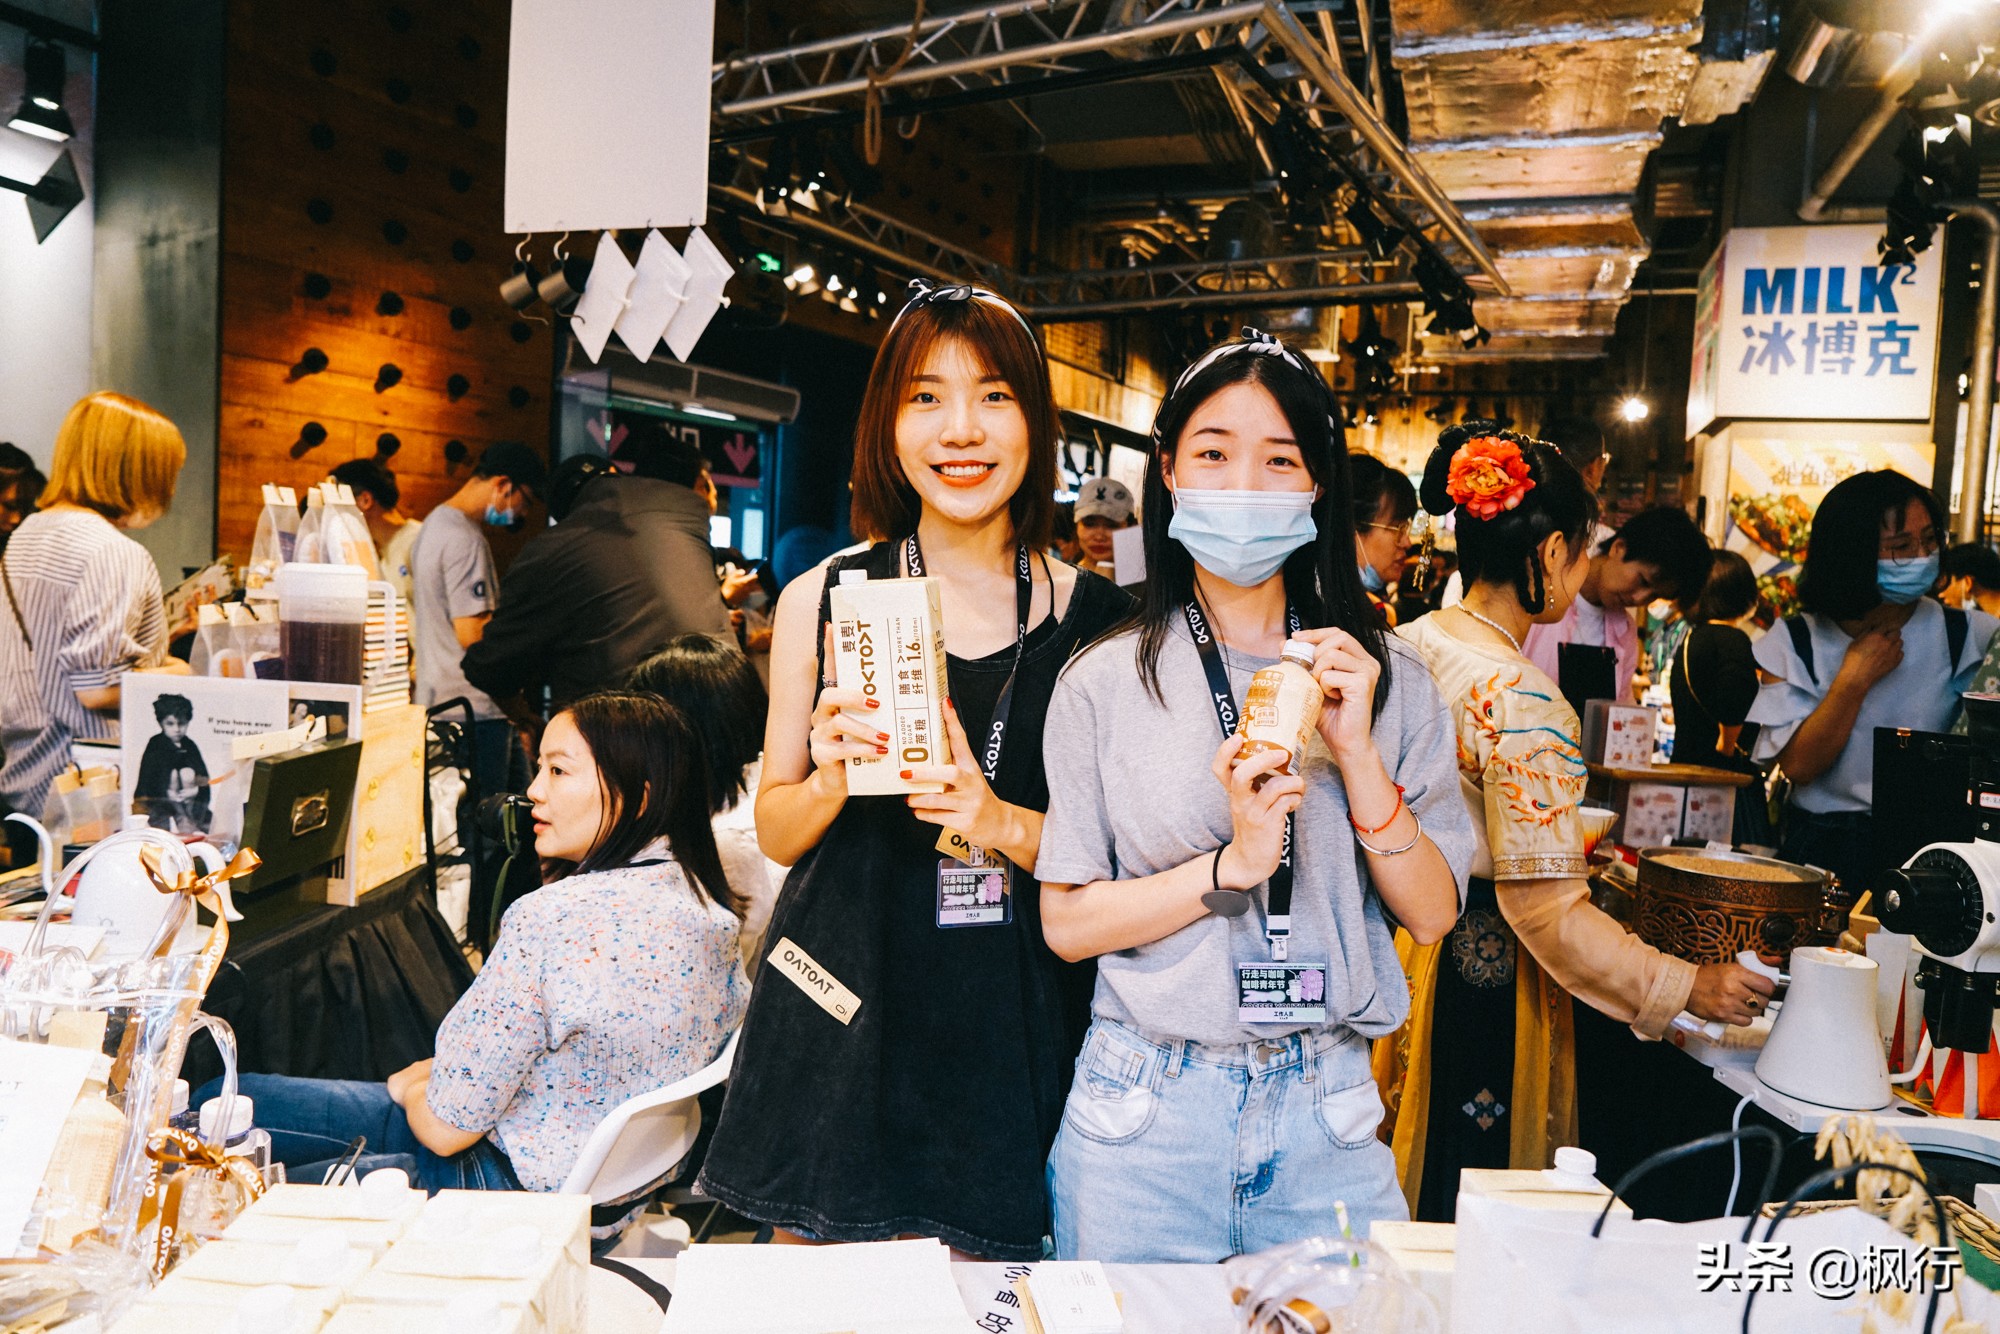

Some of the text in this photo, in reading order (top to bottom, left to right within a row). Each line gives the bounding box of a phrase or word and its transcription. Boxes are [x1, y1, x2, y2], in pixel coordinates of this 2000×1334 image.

[1739, 319, 1919, 377] 冰博克
[899, 670, 911, 695] 膳食
[911, 668, 924, 695] 纤维
[233, 719, 252, 727] have
[213, 728, 236, 736] loved
[914, 719, 928, 745] 蔗糖
[901, 734, 907, 745] NO
[942, 875, 976, 885] 行走与咖啡
[942, 884, 976, 894] 咖啡青年节
[1242, 969, 1286, 979] 行走与咖啡
[1242, 980, 1286, 990] 咖啡青年节
